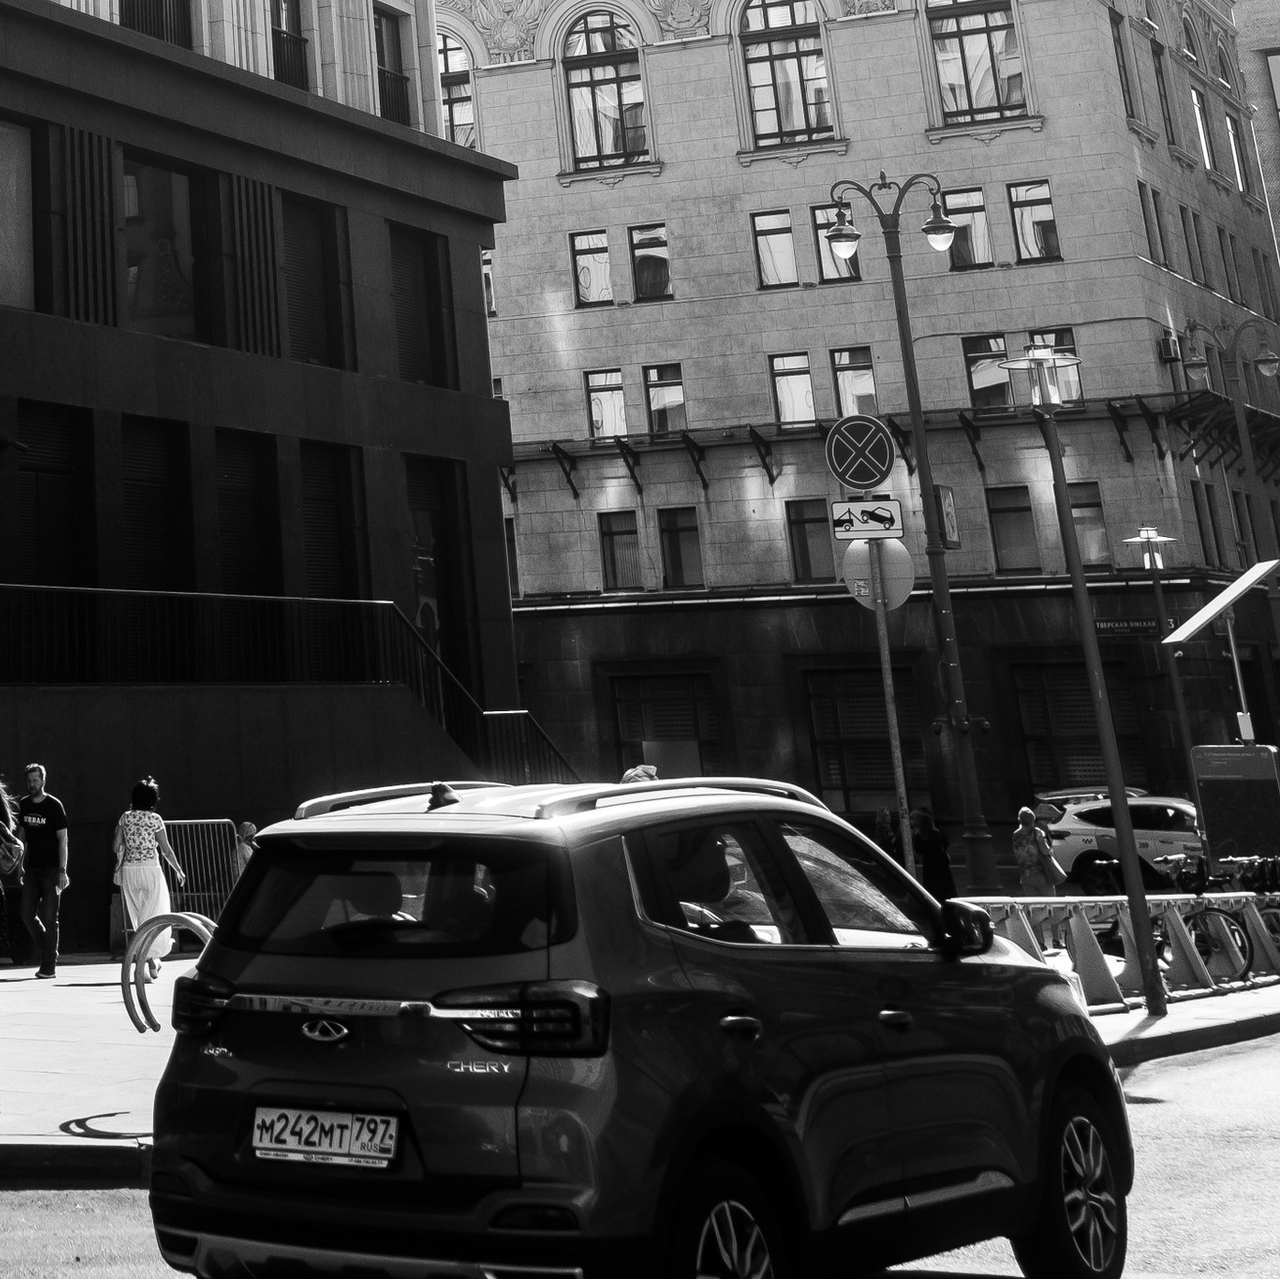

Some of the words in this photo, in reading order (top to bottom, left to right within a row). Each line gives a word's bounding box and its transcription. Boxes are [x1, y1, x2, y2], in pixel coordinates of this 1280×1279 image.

[447, 1060, 511, 1073] CHERY
[354, 1116, 391, 1144] 797
[360, 1142, 380, 1153] RUS
